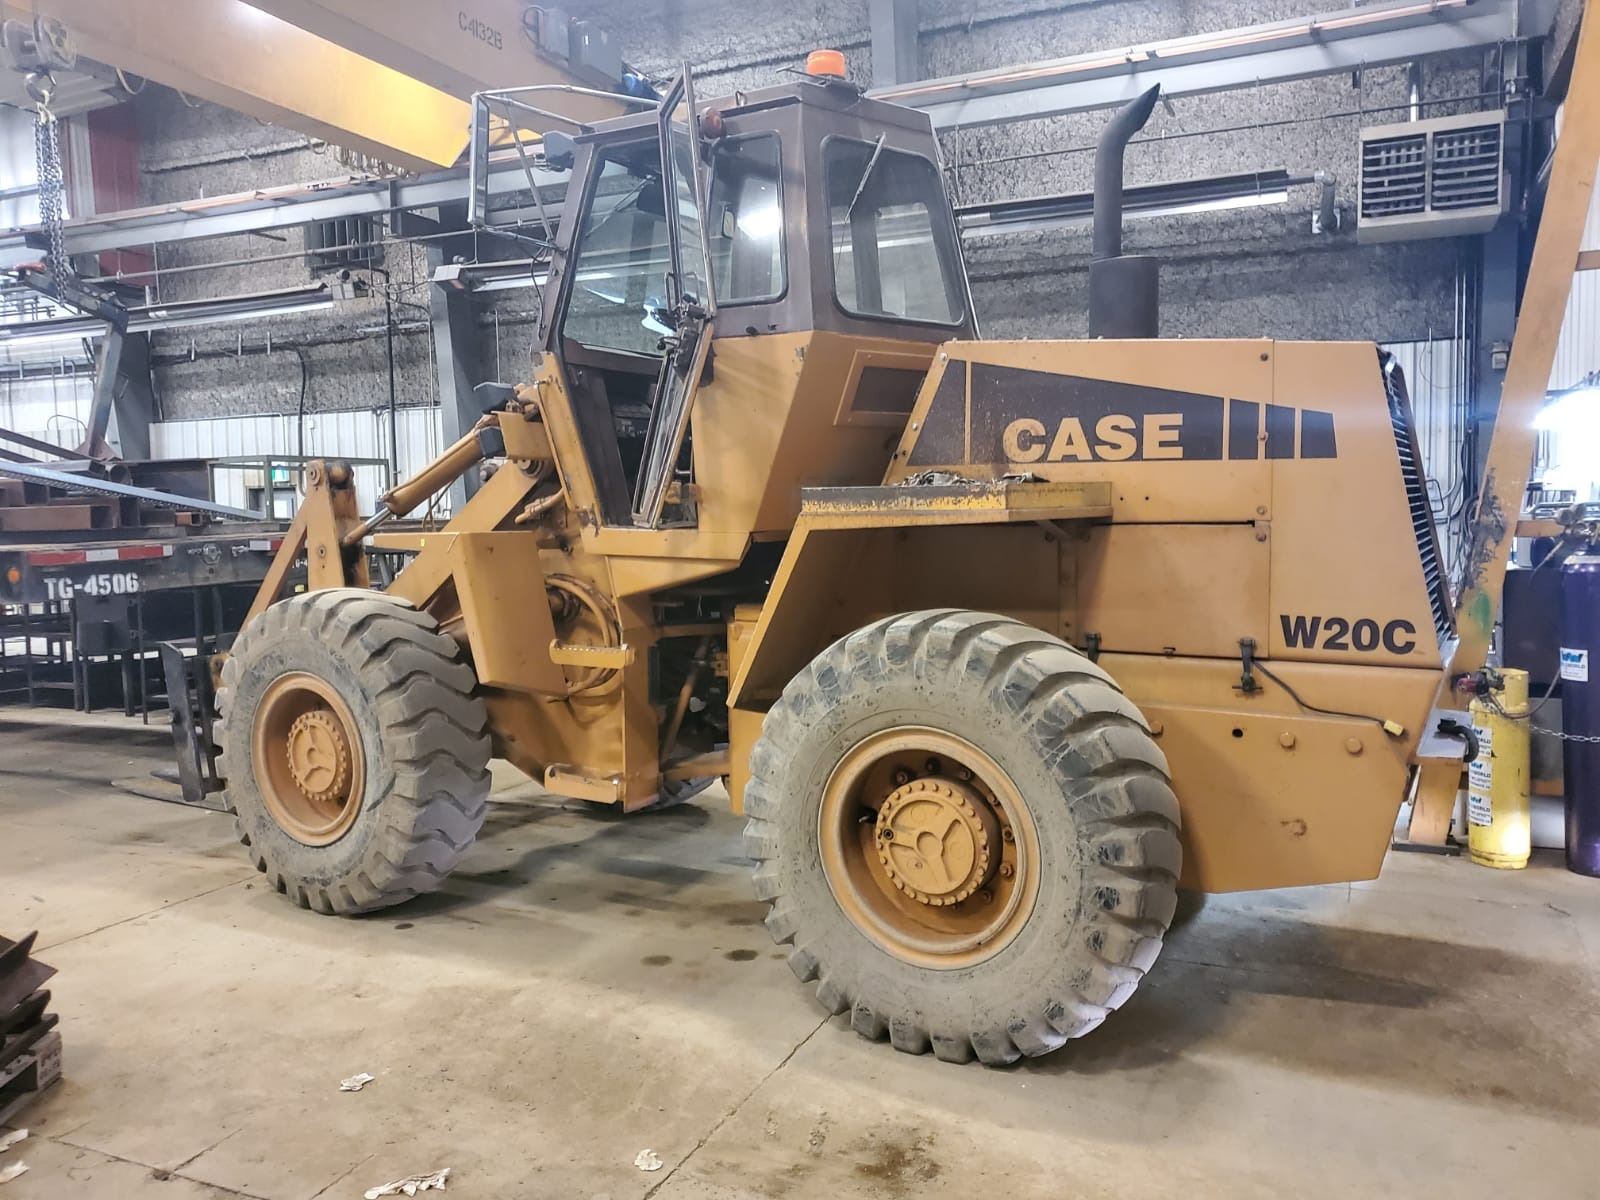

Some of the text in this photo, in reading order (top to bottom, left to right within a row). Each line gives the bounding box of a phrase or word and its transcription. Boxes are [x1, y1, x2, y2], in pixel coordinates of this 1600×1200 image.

[458, 11, 503, 50] C4132B
[1002, 413, 1183, 463] CASE
[43, 572, 139, 600] TG-4506
[1280, 615, 1416, 655] W20C
